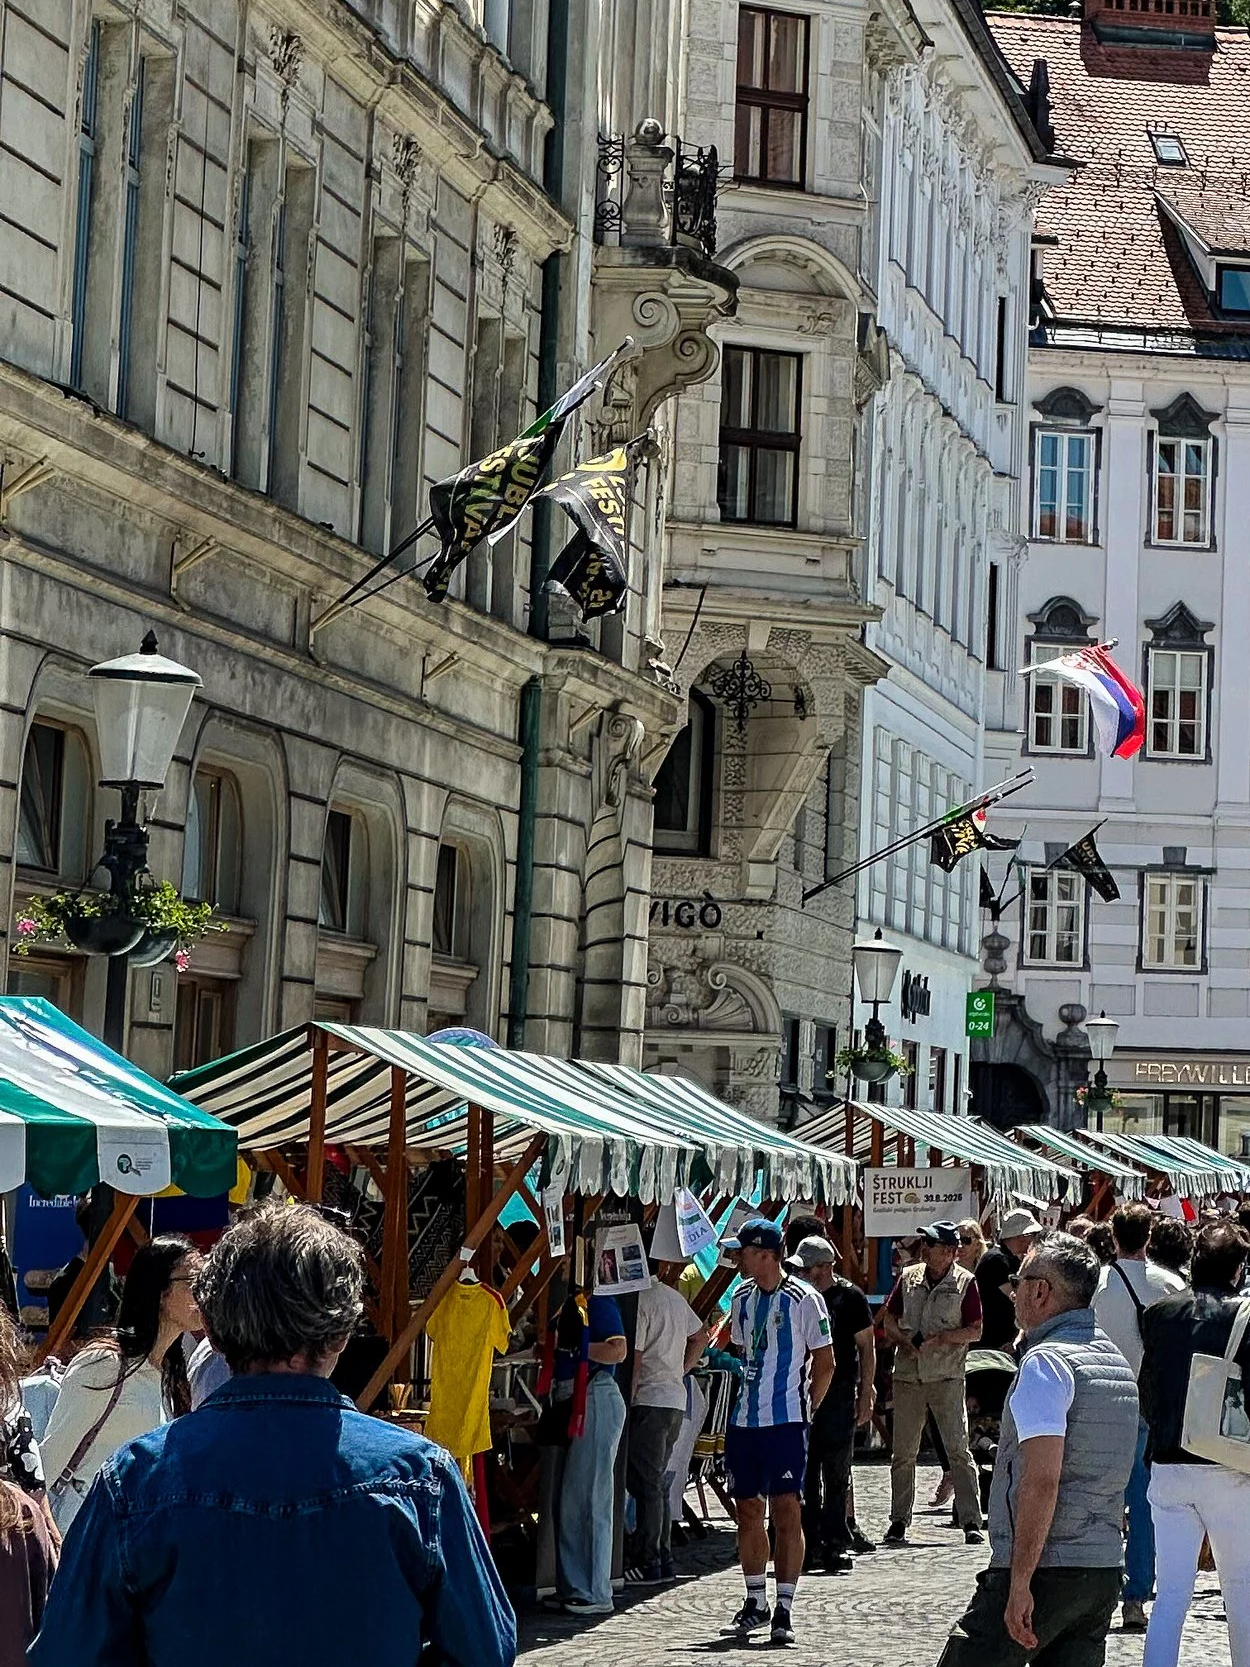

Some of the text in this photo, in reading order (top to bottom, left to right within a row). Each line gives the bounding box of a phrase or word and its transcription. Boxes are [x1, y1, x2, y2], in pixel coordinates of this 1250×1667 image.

[968, 1021, 990, 1031] 0-24
[872, 1174, 933, 1190] ŠTRUKLJI
[873, 1192, 903, 1205] FEST
